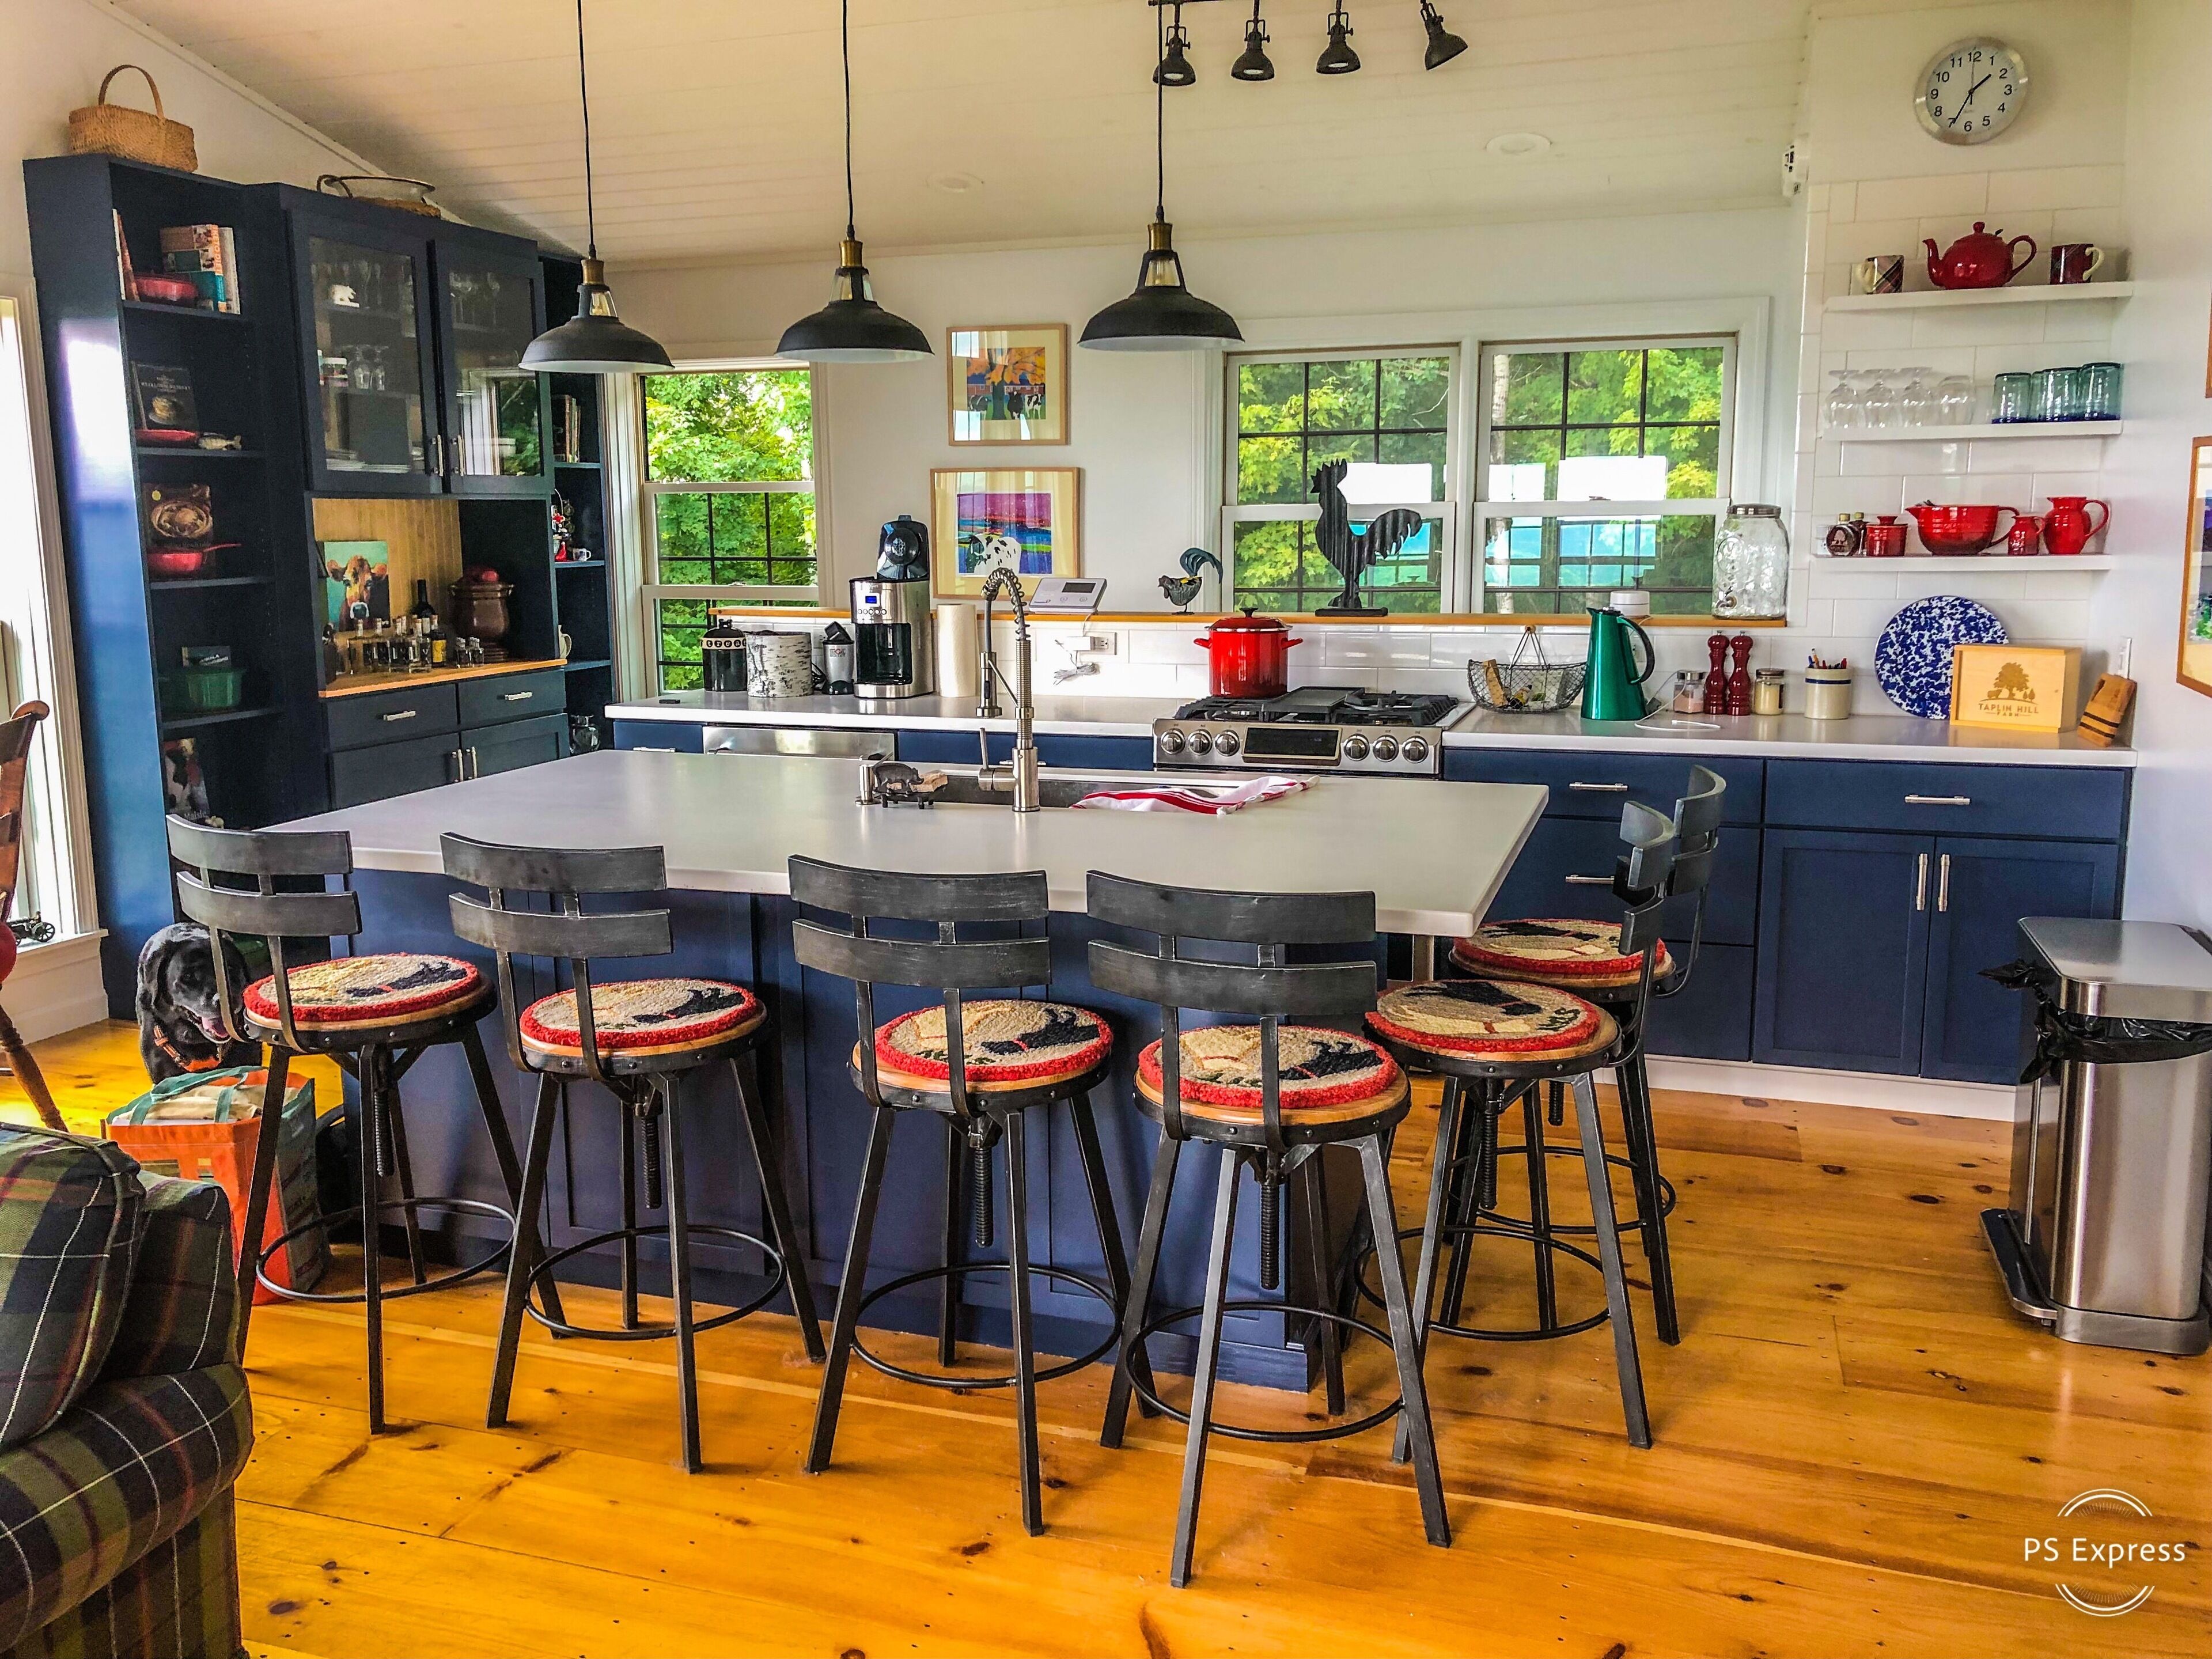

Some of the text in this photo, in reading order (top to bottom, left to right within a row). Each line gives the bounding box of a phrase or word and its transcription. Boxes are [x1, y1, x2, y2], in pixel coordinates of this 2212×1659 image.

[1968, 51, 1982, 62] 12
[1990, 55, 1994, 65] 1
[1950, 57, 1962, 67] 11
[1936, 71, 1950, 82] 10
[1999, 68, 2008, 79] 2
[1931, 89, 1938, 99] 9
[2004, 84, 2012, 95] 3
[1934, 106, 1942, 116] 8
[1998, 103, 2005, 112] 4
[1948, 118, 1957, 128] 7
[1982, 116, 1991, 126] 5
[1964, 121, 1972, 132] 6
[1978, 703, 2039, 714] TAPLIN HILL
